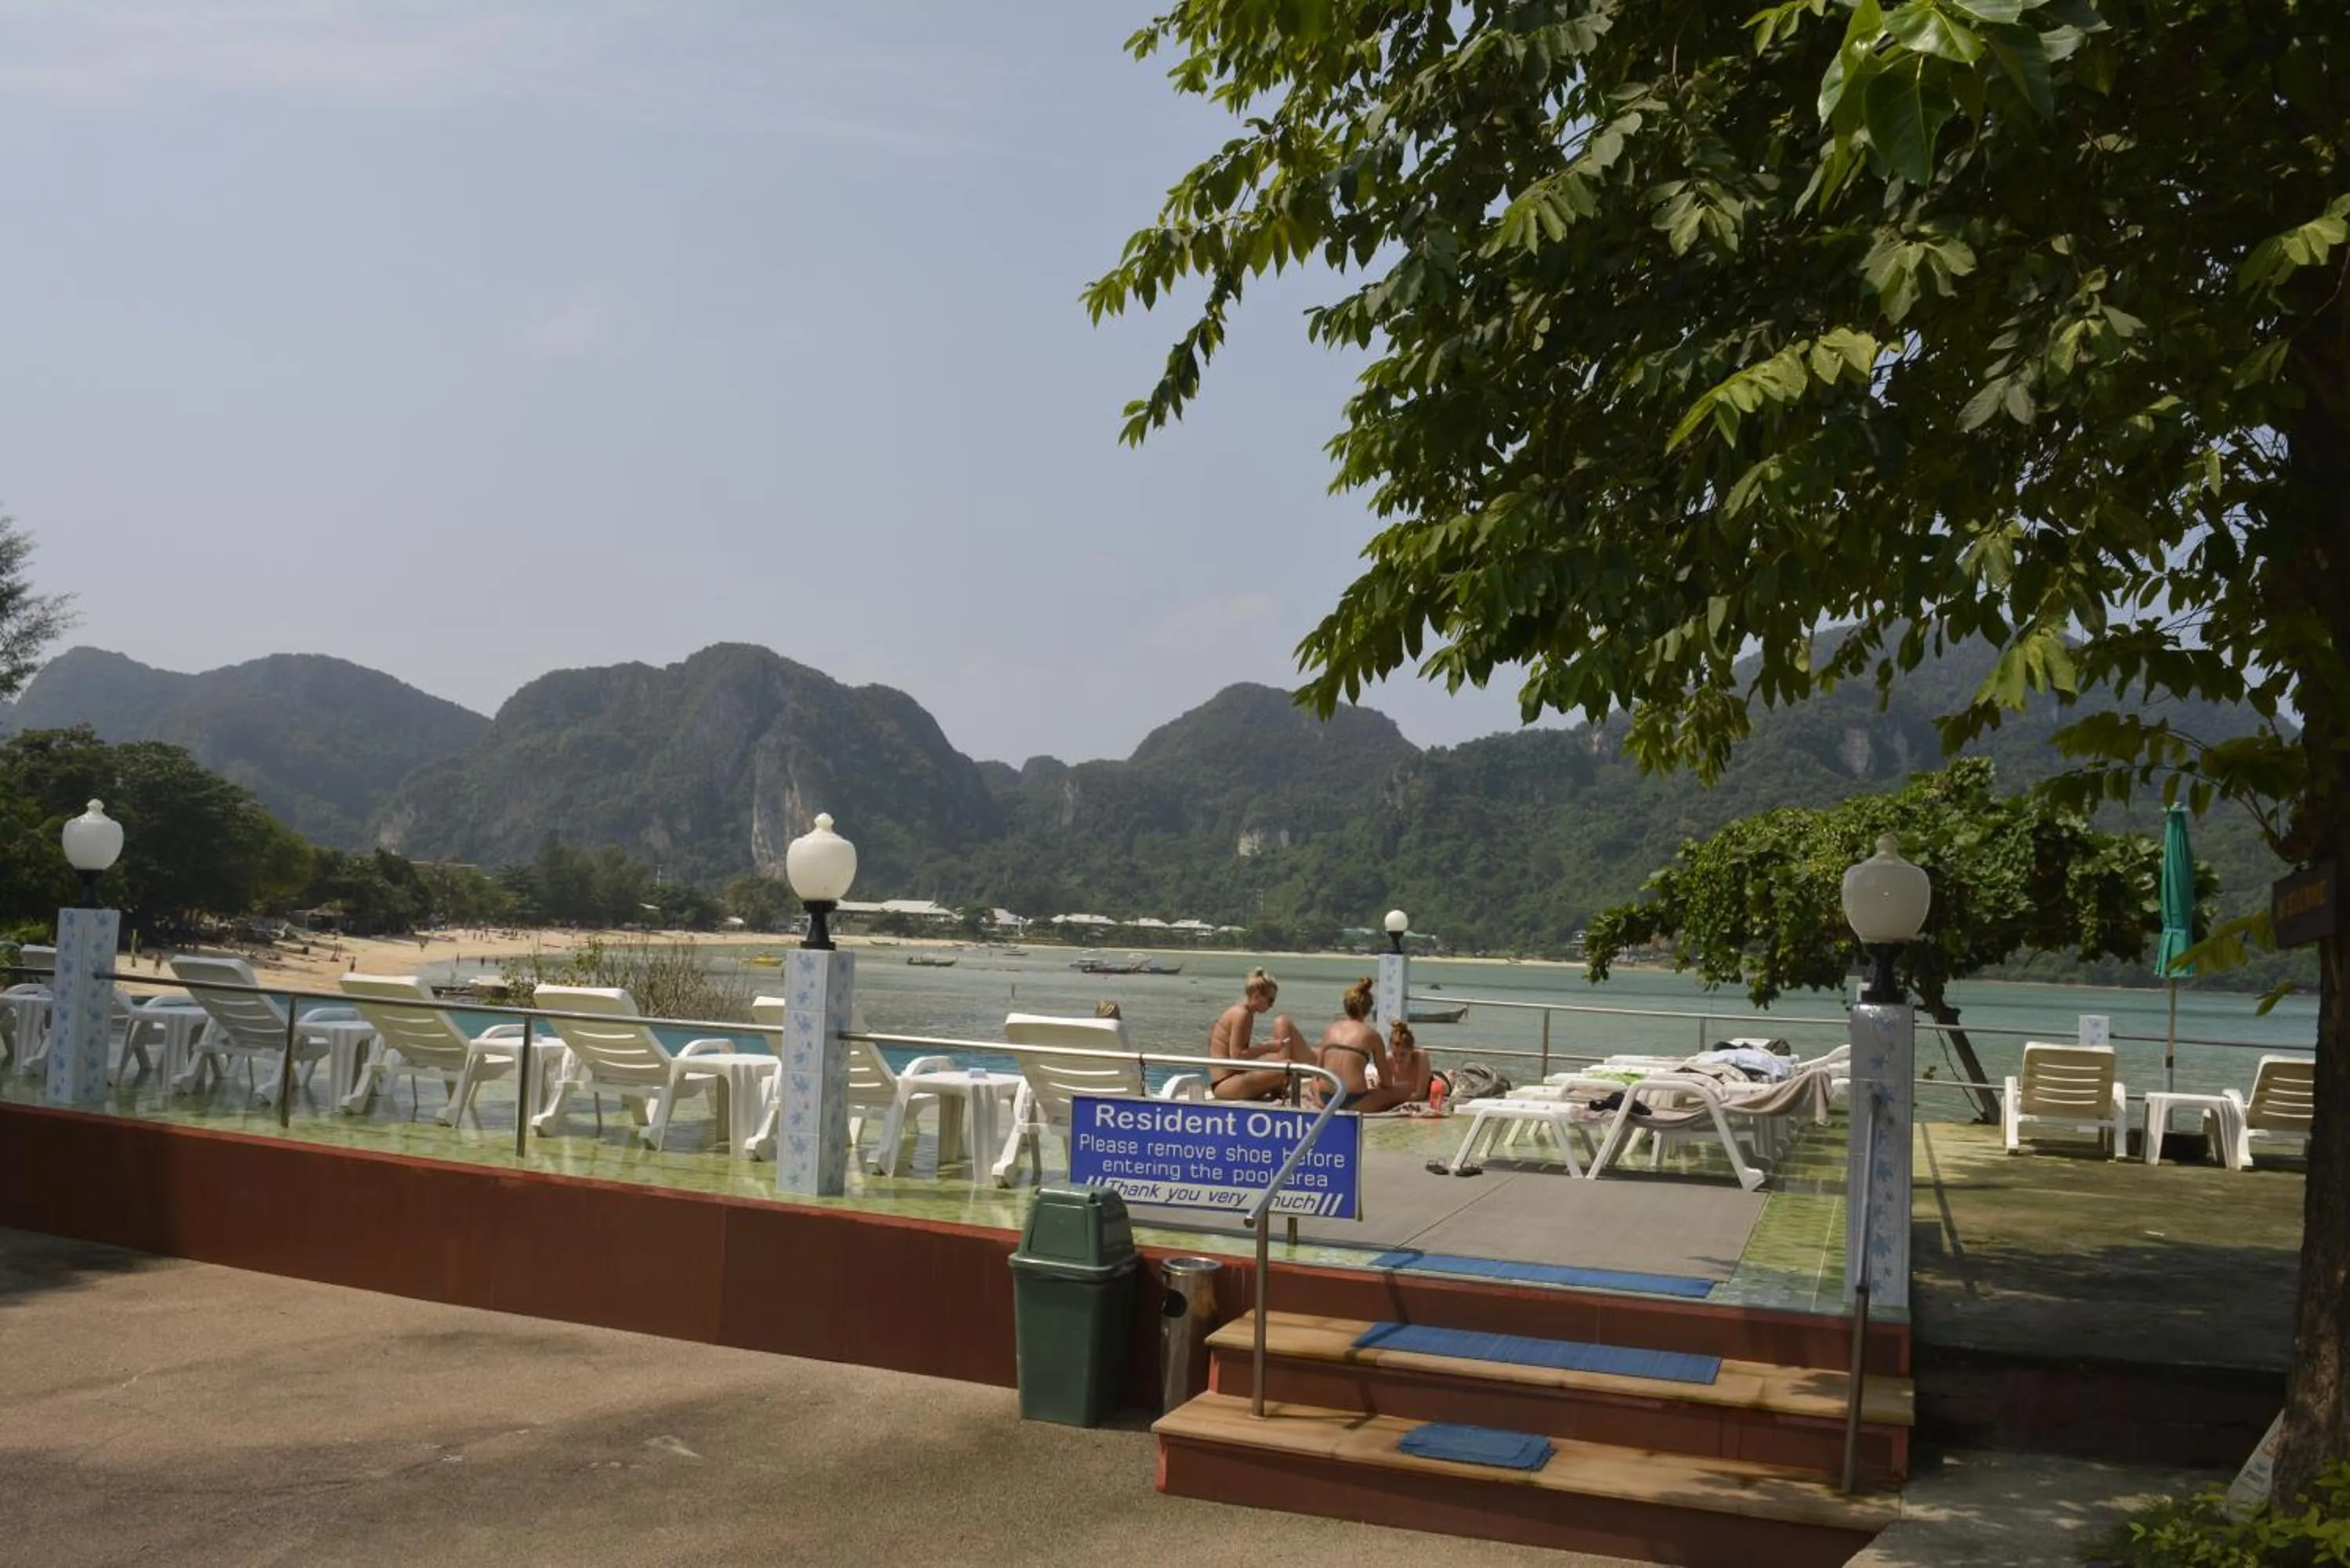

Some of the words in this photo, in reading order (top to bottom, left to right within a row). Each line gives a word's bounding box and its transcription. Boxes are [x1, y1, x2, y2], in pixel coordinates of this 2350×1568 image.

[1095, 1104, 1238, 1136] Resident
[1079, 1133, 1138, 1155] Please
[1147, 1142, 1217, 1160] remove
[1226, 1144, 1273, 1164] shoe
[1102, 1158, 1181, 1180] entering
[1190, 1163, 1223, 1180] the
[1233, 1168, 1274, 1185] pool
[1285, 1173, 1329, 1187] area
[1109, 1177, 1161, 1198] Thank
[1165, 1187, 1202, 1202] you
[1207, 1190, 1248, 1207] very
